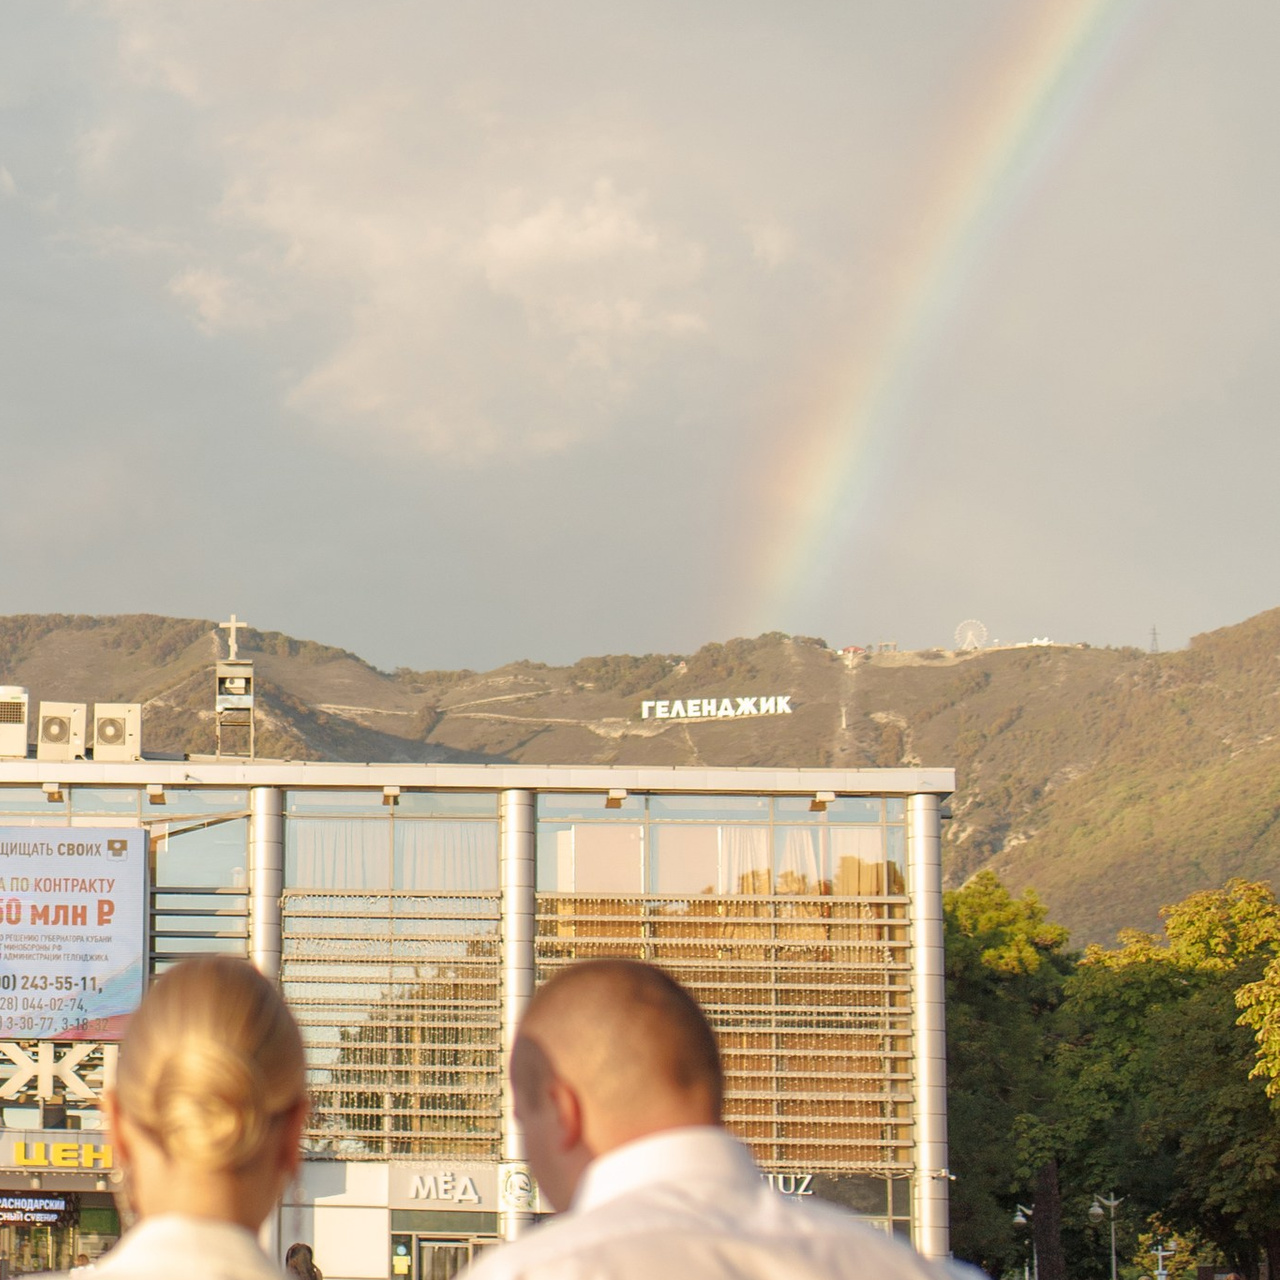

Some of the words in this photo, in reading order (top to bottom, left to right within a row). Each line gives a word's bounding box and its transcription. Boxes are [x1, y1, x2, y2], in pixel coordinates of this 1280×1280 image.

[642, 696, 792, 718] ГЕЛЕНДЖИК
[57, 843, 102, 856] СВОИХ
[10, 877, 30, 892] ПО
[34, 878, 116, 894] КОНТРАКТУ
[40, 934, 85, 942] ГУБЕРНАТОРА
[20, 975, 103, 994] 243-55-11,
[22, 997, 88, 1013] 044-02-74,
[6, 1016, 58, 1032] 3-30-77,
[14, 1141, 113, 1169] ЦЕН
[409, 1171, 480, 1204] МЁД
[24, 1213, 58, 1222] СУВЕНИР
